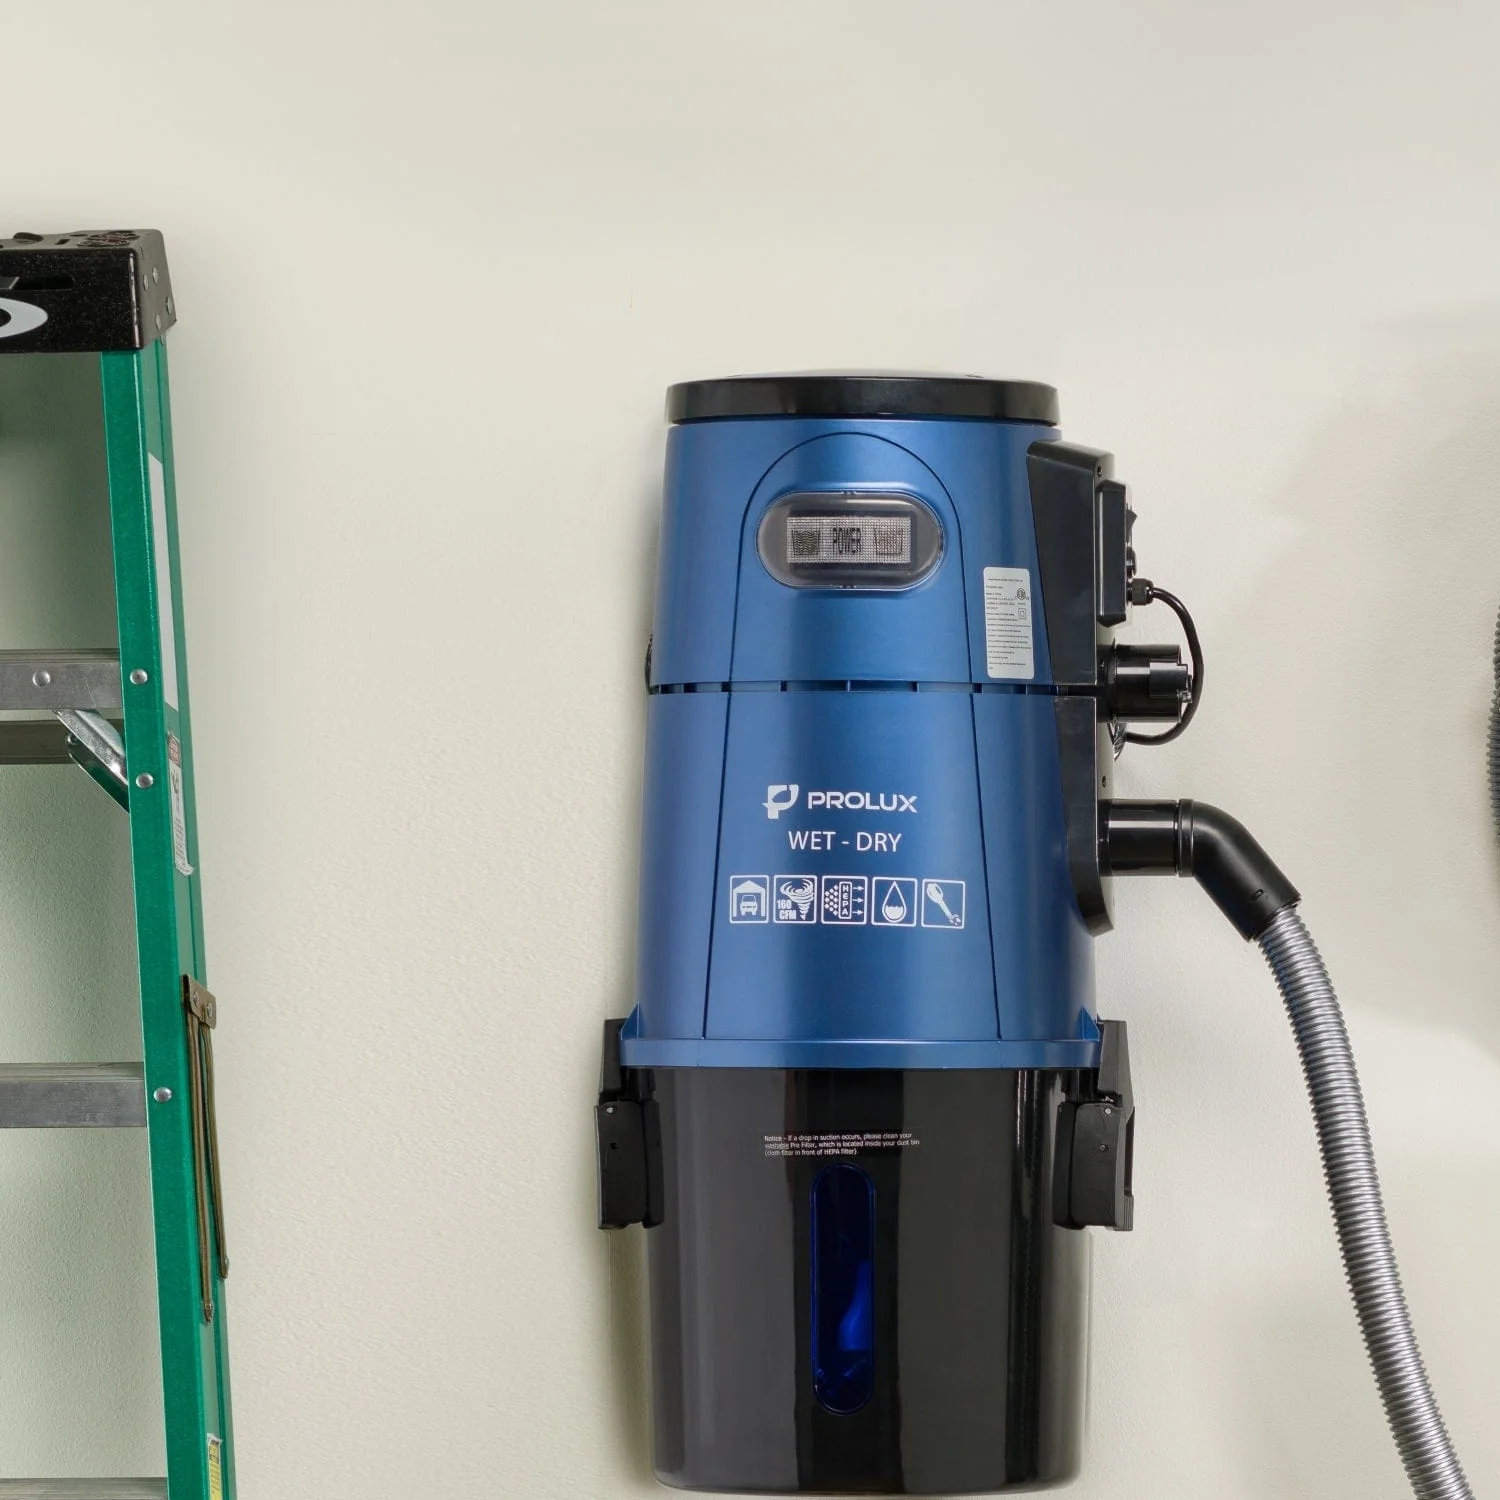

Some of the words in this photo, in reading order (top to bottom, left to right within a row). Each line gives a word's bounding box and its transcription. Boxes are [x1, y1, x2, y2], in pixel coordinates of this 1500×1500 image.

[832, 527, 861, 553] POWER
[807, 791, 918, 813] PROLUX
[788, 830, 836, 850] WET
[856, 832, 902, 853] DRY
[776, 900, 792, 910] 160
[779, 909, 797, 920] CFM
[798, 1135, 812, 1143] drop
